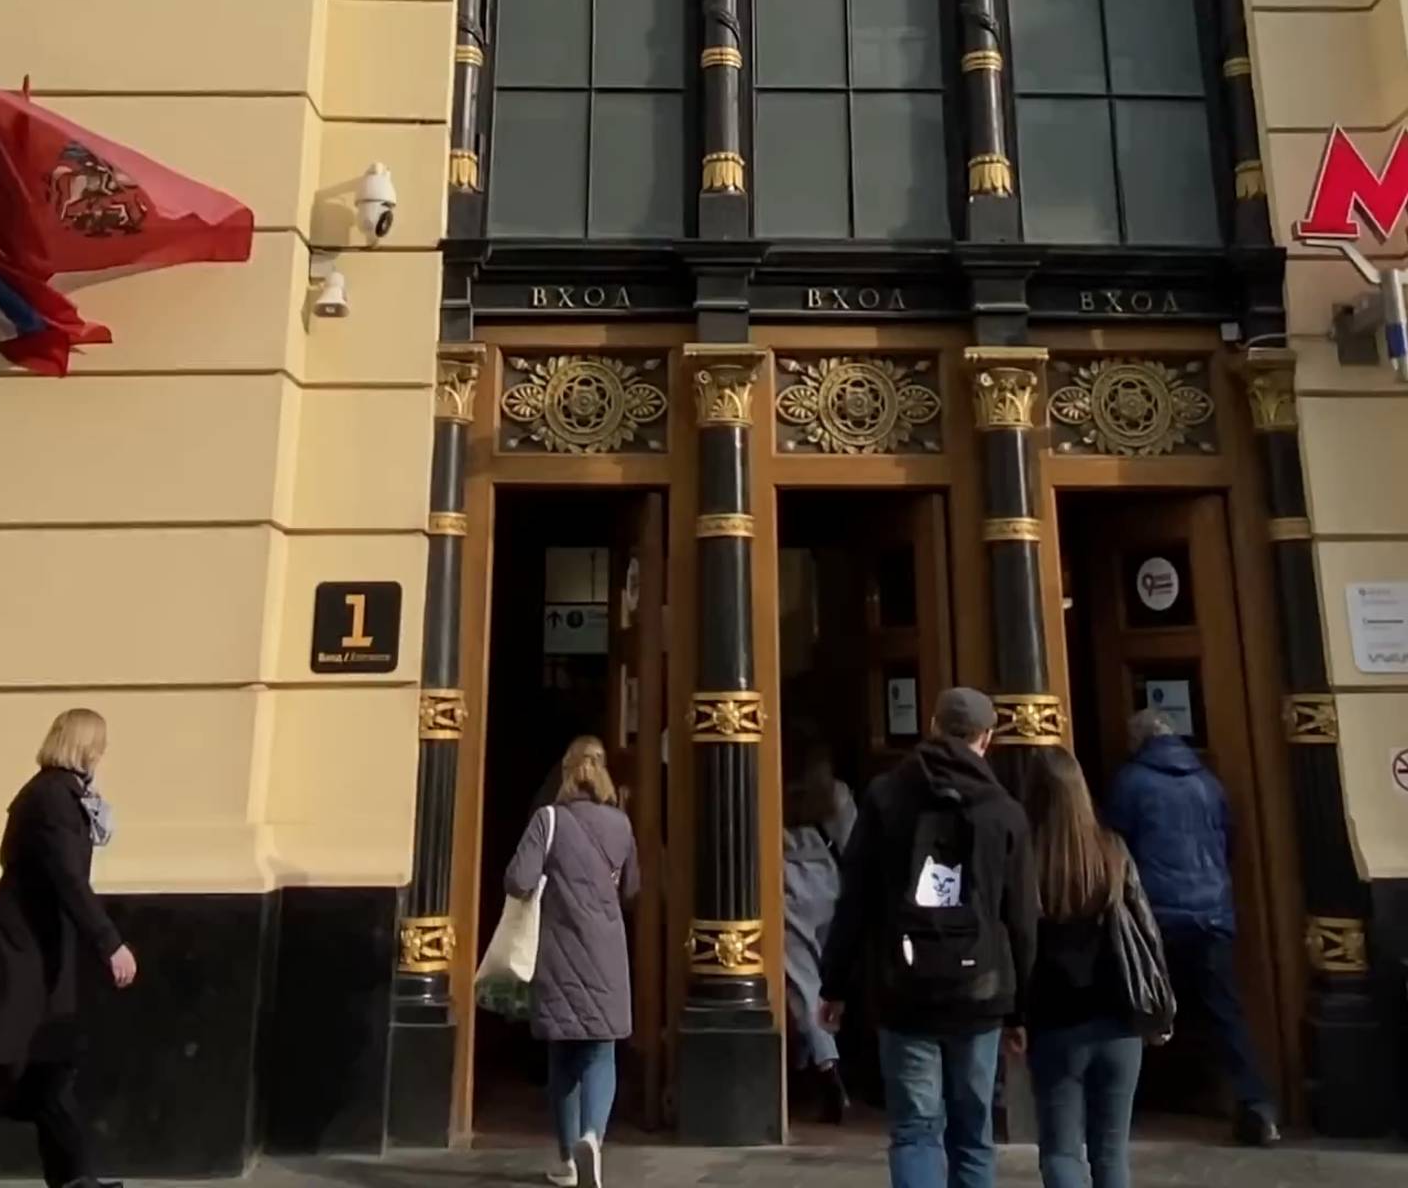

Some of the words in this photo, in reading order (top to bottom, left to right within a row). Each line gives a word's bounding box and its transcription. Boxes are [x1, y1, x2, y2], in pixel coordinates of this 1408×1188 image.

[531, 285, 631, 308] ВХОД
[807, 287, 907, 310] ВХОД
[1079, 290, 1179, 313] ВХОД
[341, 594, 373, 647] 1
